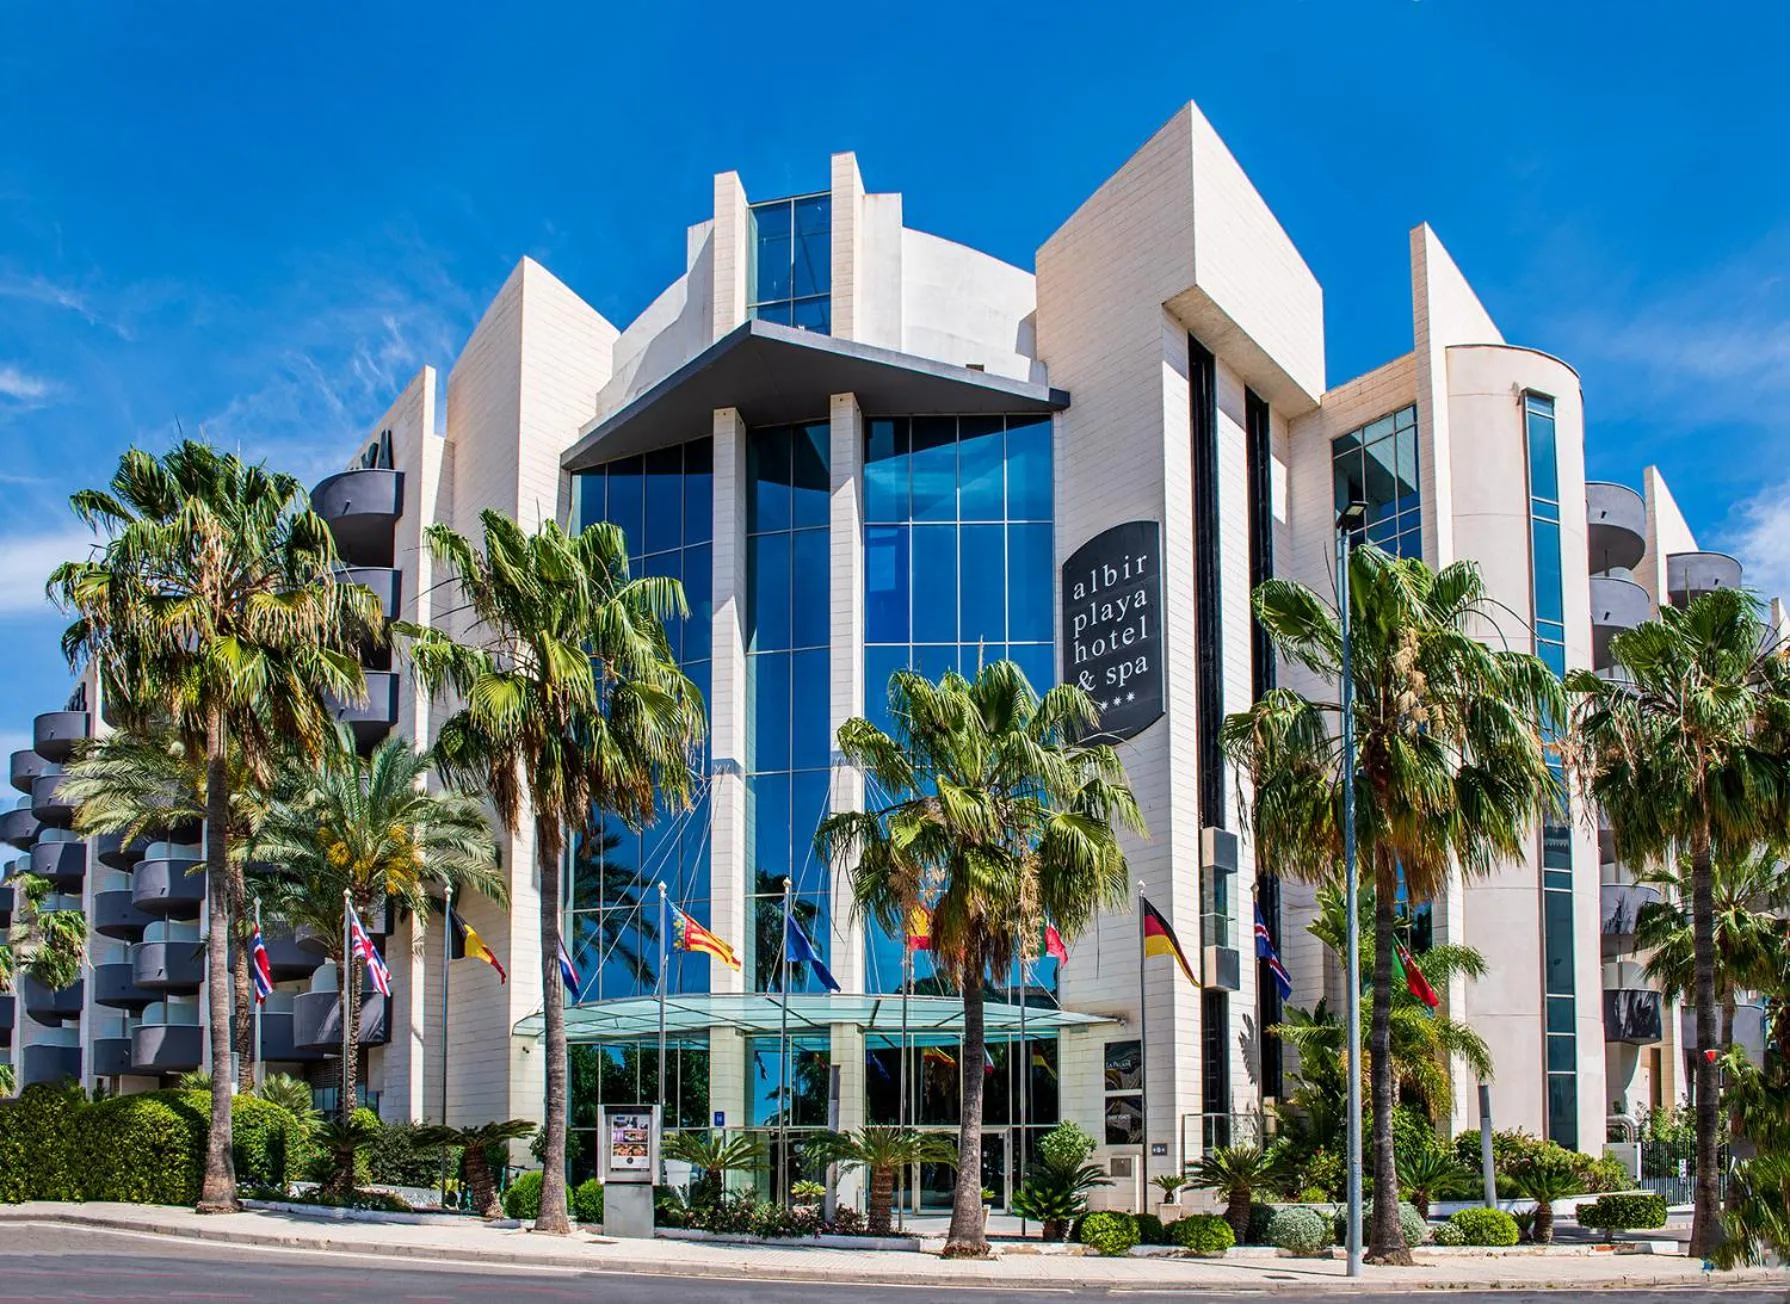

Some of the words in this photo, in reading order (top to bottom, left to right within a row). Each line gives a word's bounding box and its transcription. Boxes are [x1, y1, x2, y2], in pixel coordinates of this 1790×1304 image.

[1073, 555, 1147, 600] albir
[1073, 590, 1147, 638] playa
[1074, 616, 1148, 664] hotel
[1078, 669, 1096, 692] &
[1106, 655, 1149, 687] spa
